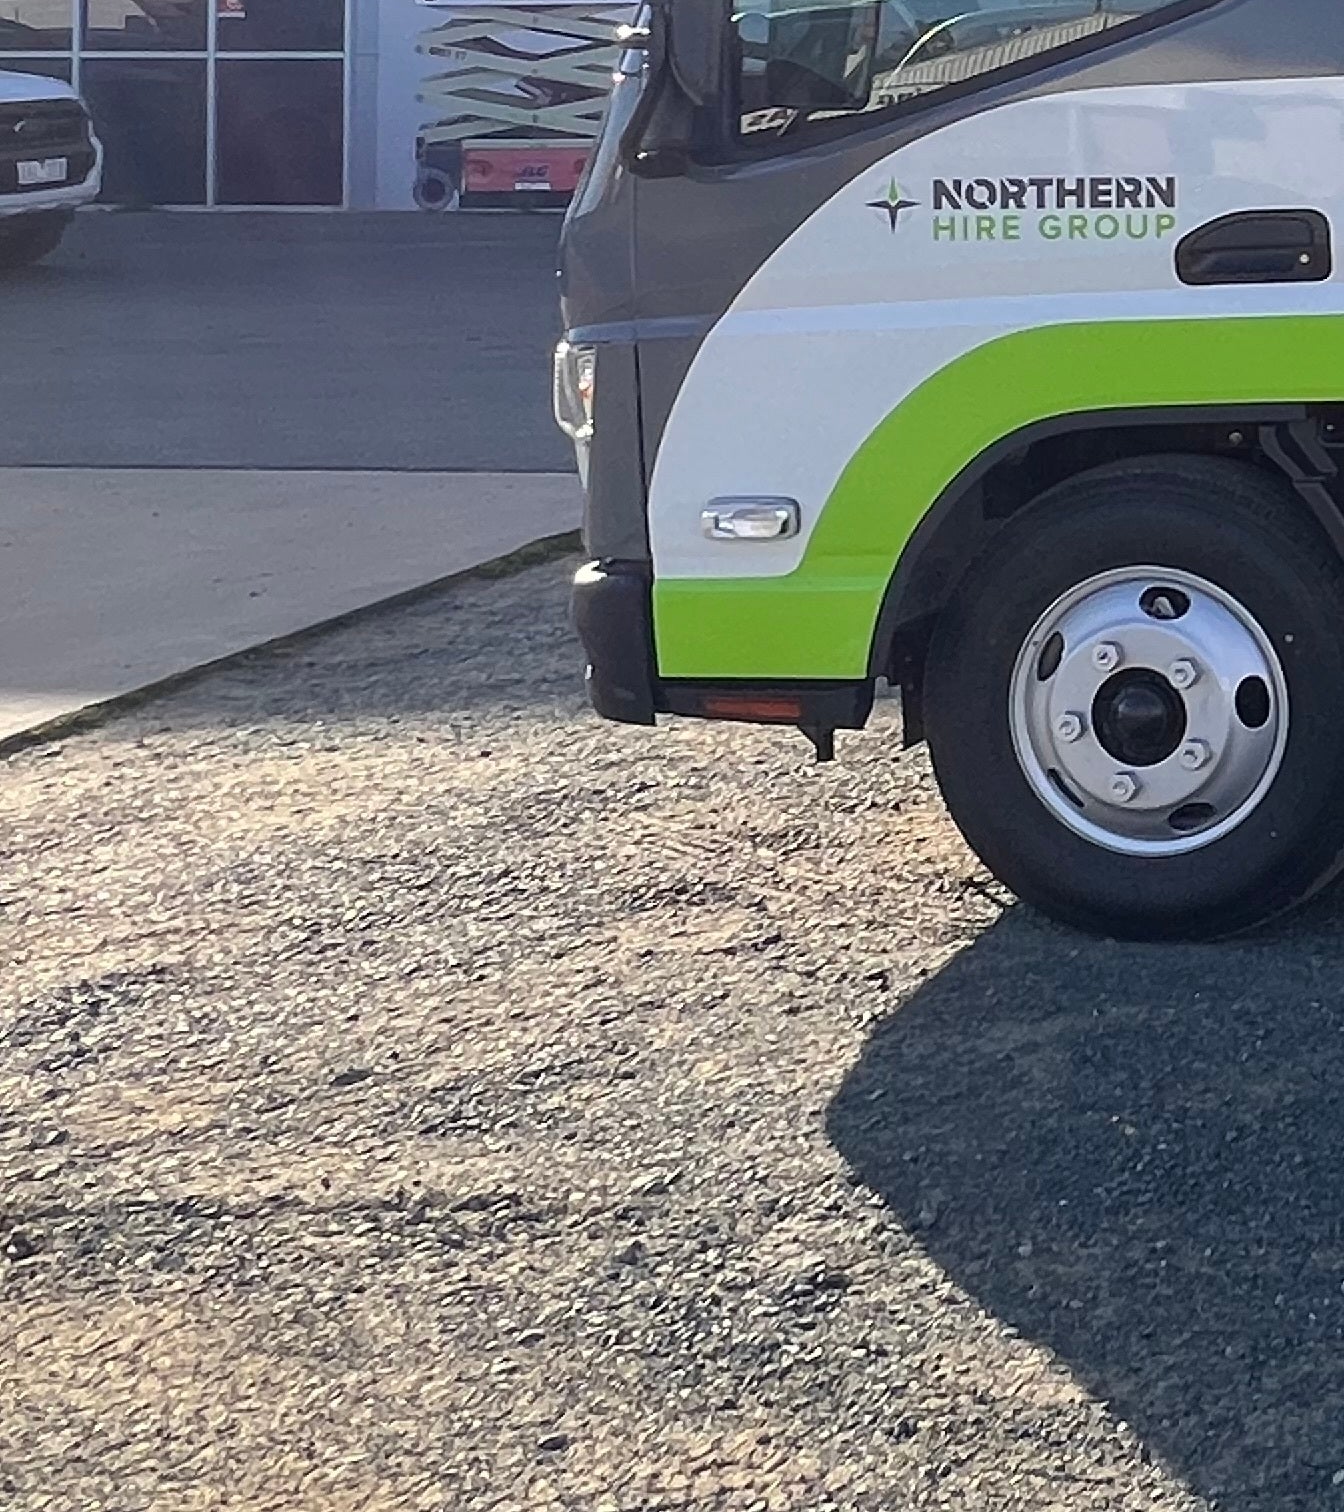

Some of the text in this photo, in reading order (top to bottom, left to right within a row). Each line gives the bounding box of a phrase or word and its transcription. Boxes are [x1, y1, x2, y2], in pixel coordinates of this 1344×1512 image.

[932, 176, 1176, 210] NORTHERN
[932, 213, 1176, 241] HIRE GROUP
